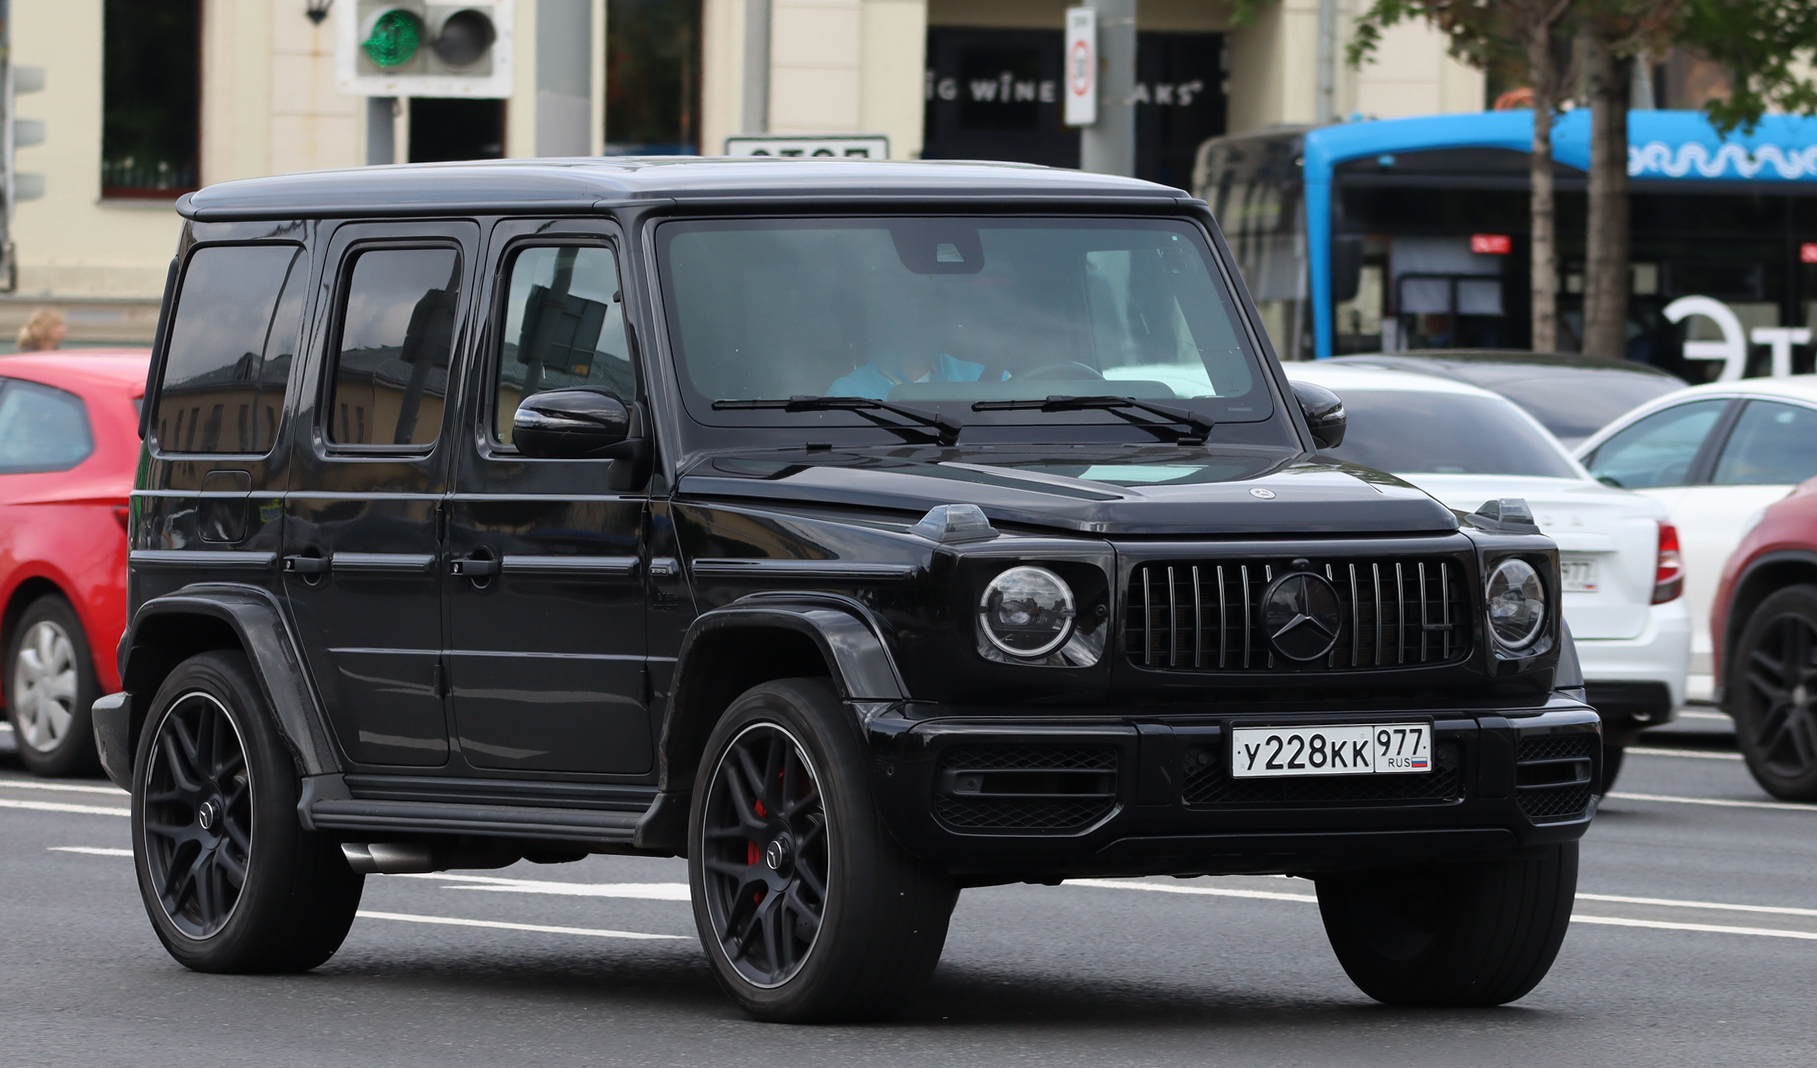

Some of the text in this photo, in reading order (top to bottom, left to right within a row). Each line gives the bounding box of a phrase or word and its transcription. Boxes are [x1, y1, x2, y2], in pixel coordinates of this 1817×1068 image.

[925, 71, 957, 101] IG
[970, 71, 1056, 103] WINE
[1662, 295, 1817, 382] Эт
[1376, 728, 1424, 757] 977
[1388, 757, 1411, 768] RUS
